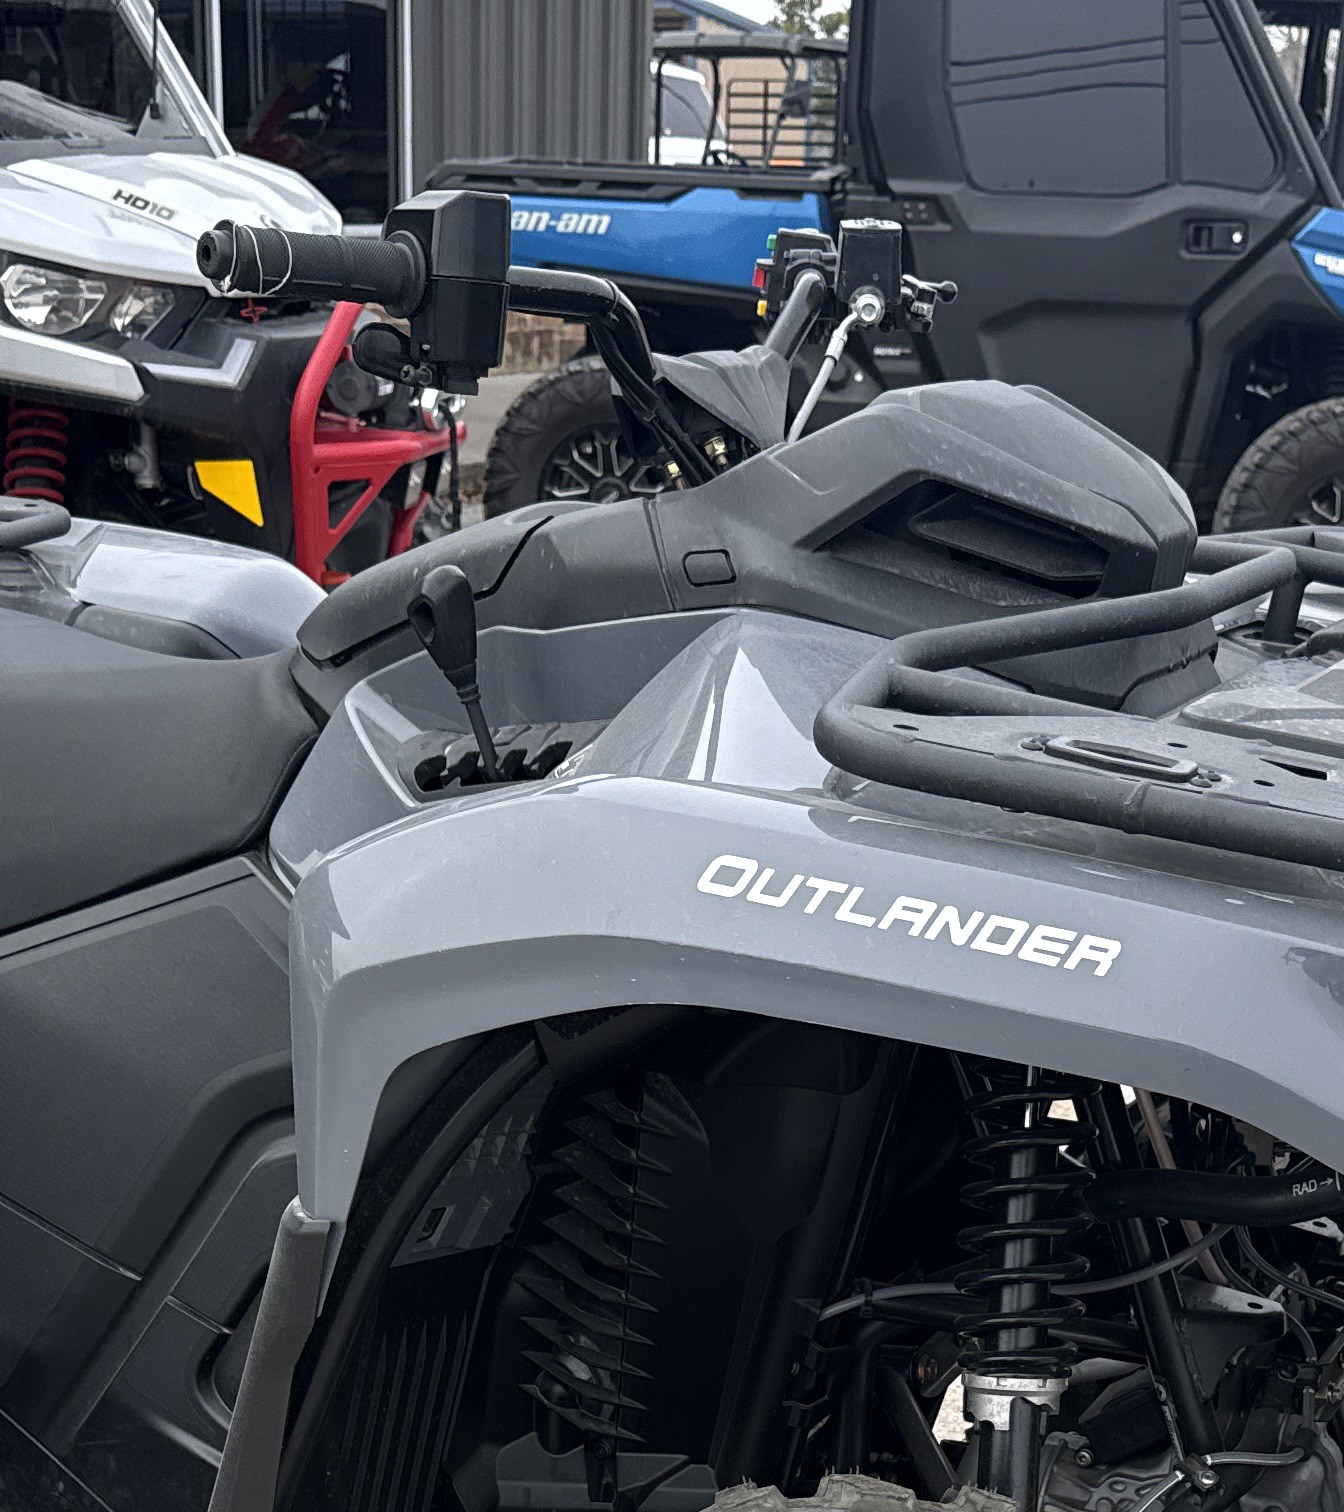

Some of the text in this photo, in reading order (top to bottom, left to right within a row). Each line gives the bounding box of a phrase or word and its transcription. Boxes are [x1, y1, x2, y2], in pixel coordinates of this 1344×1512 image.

[112, 189, 176, 220] HD10
[510, 210, 612, 235] an-am
[696, 854, 1122, 977] OUTLANDER
[1292, 1179, 1318, 1197] RAD
